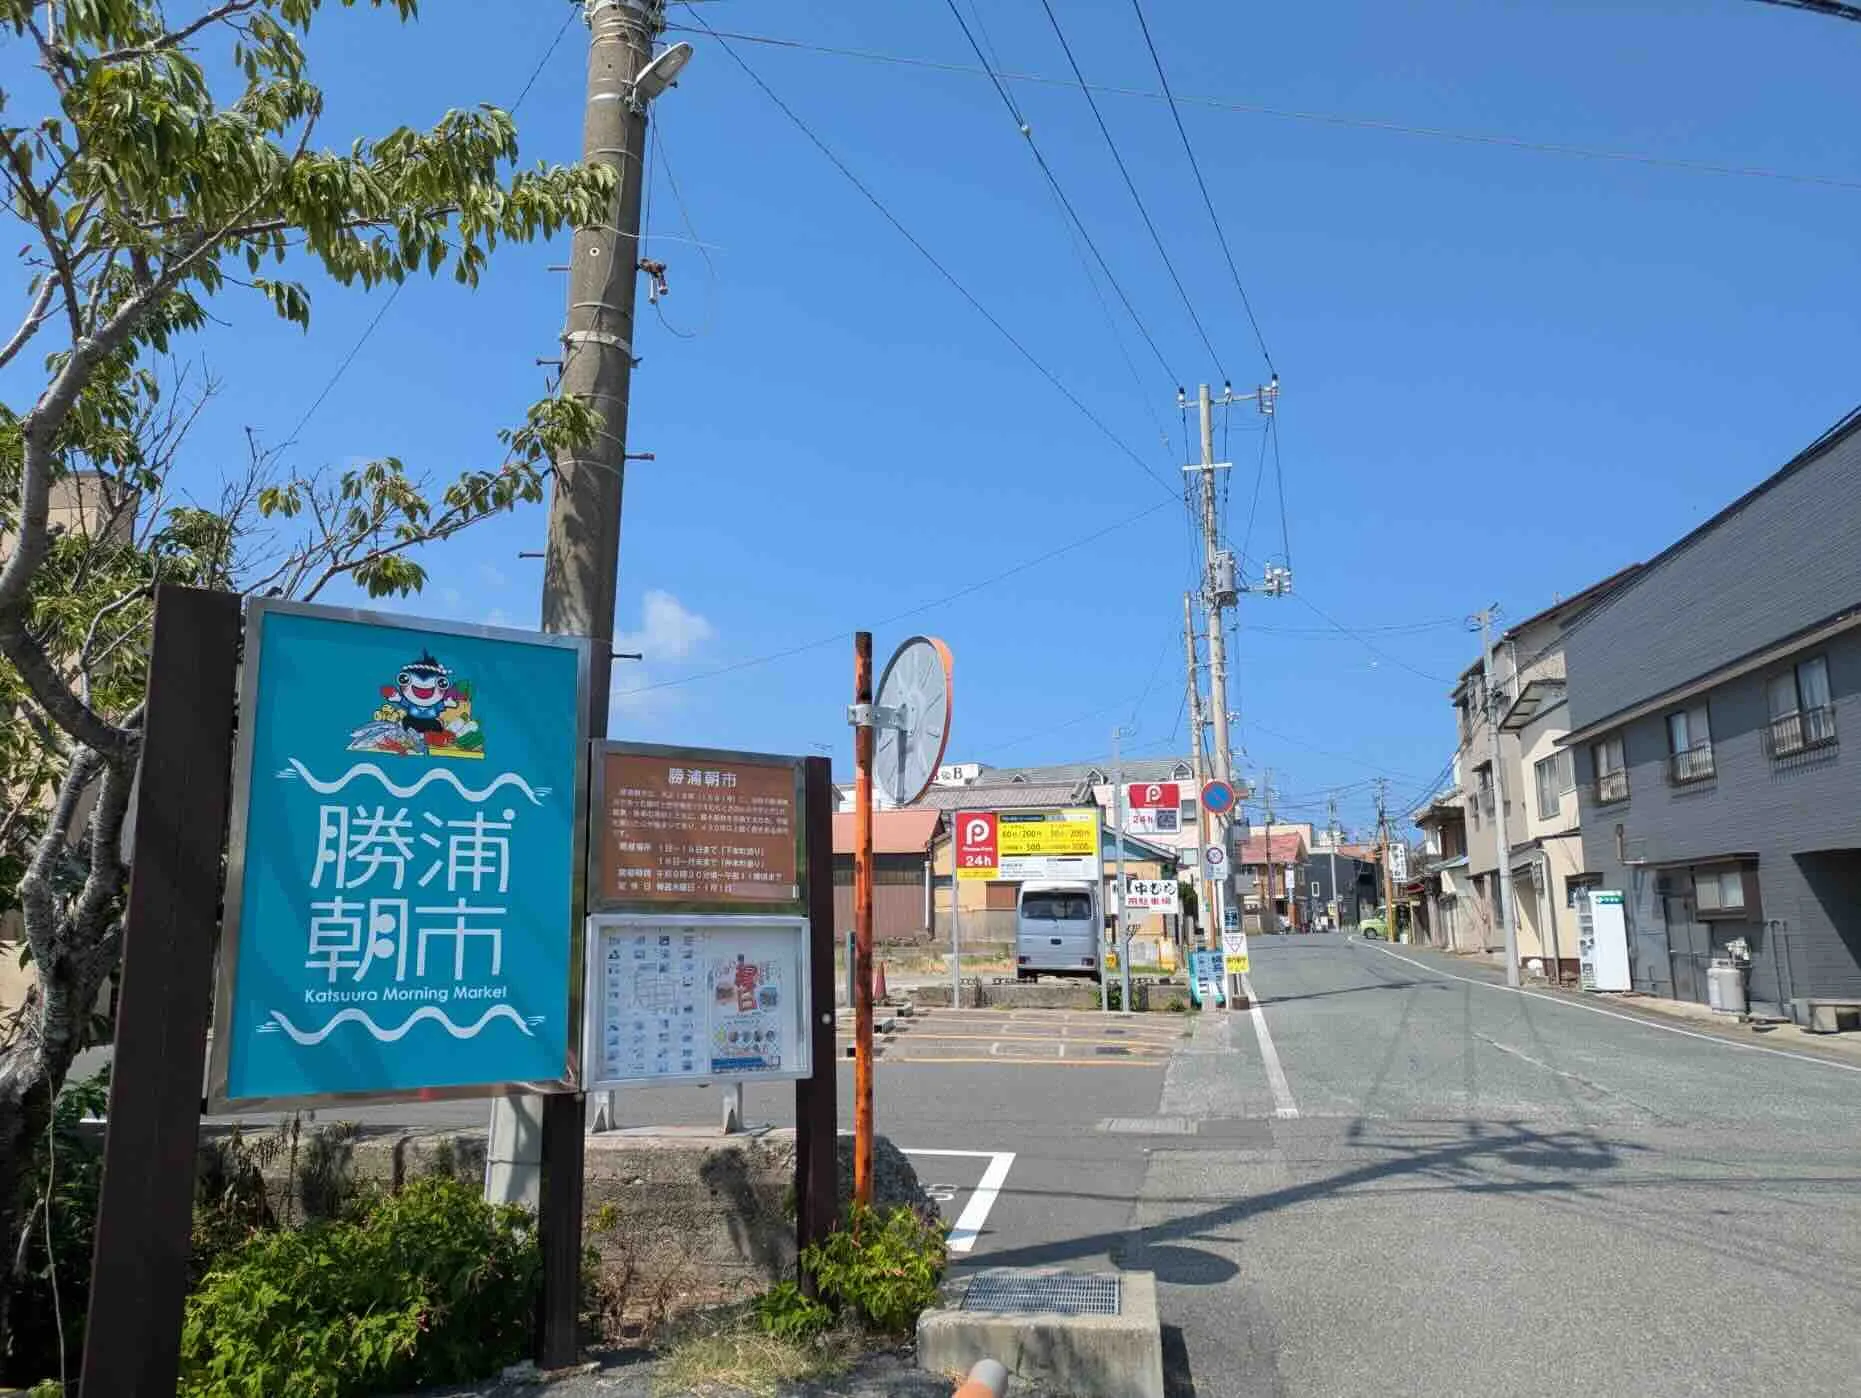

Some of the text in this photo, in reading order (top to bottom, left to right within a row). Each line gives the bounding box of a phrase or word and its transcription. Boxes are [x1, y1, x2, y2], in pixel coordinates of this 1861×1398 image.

[668, 767, 737, 789] 勝浦朝市
[310, 804, 516, 893] 勝浦
[965, 855, 992, 867] 24h
[304, 896, 508, 983] 朝市
[304, 985, 507, 1003] Katsuura Morning Market
